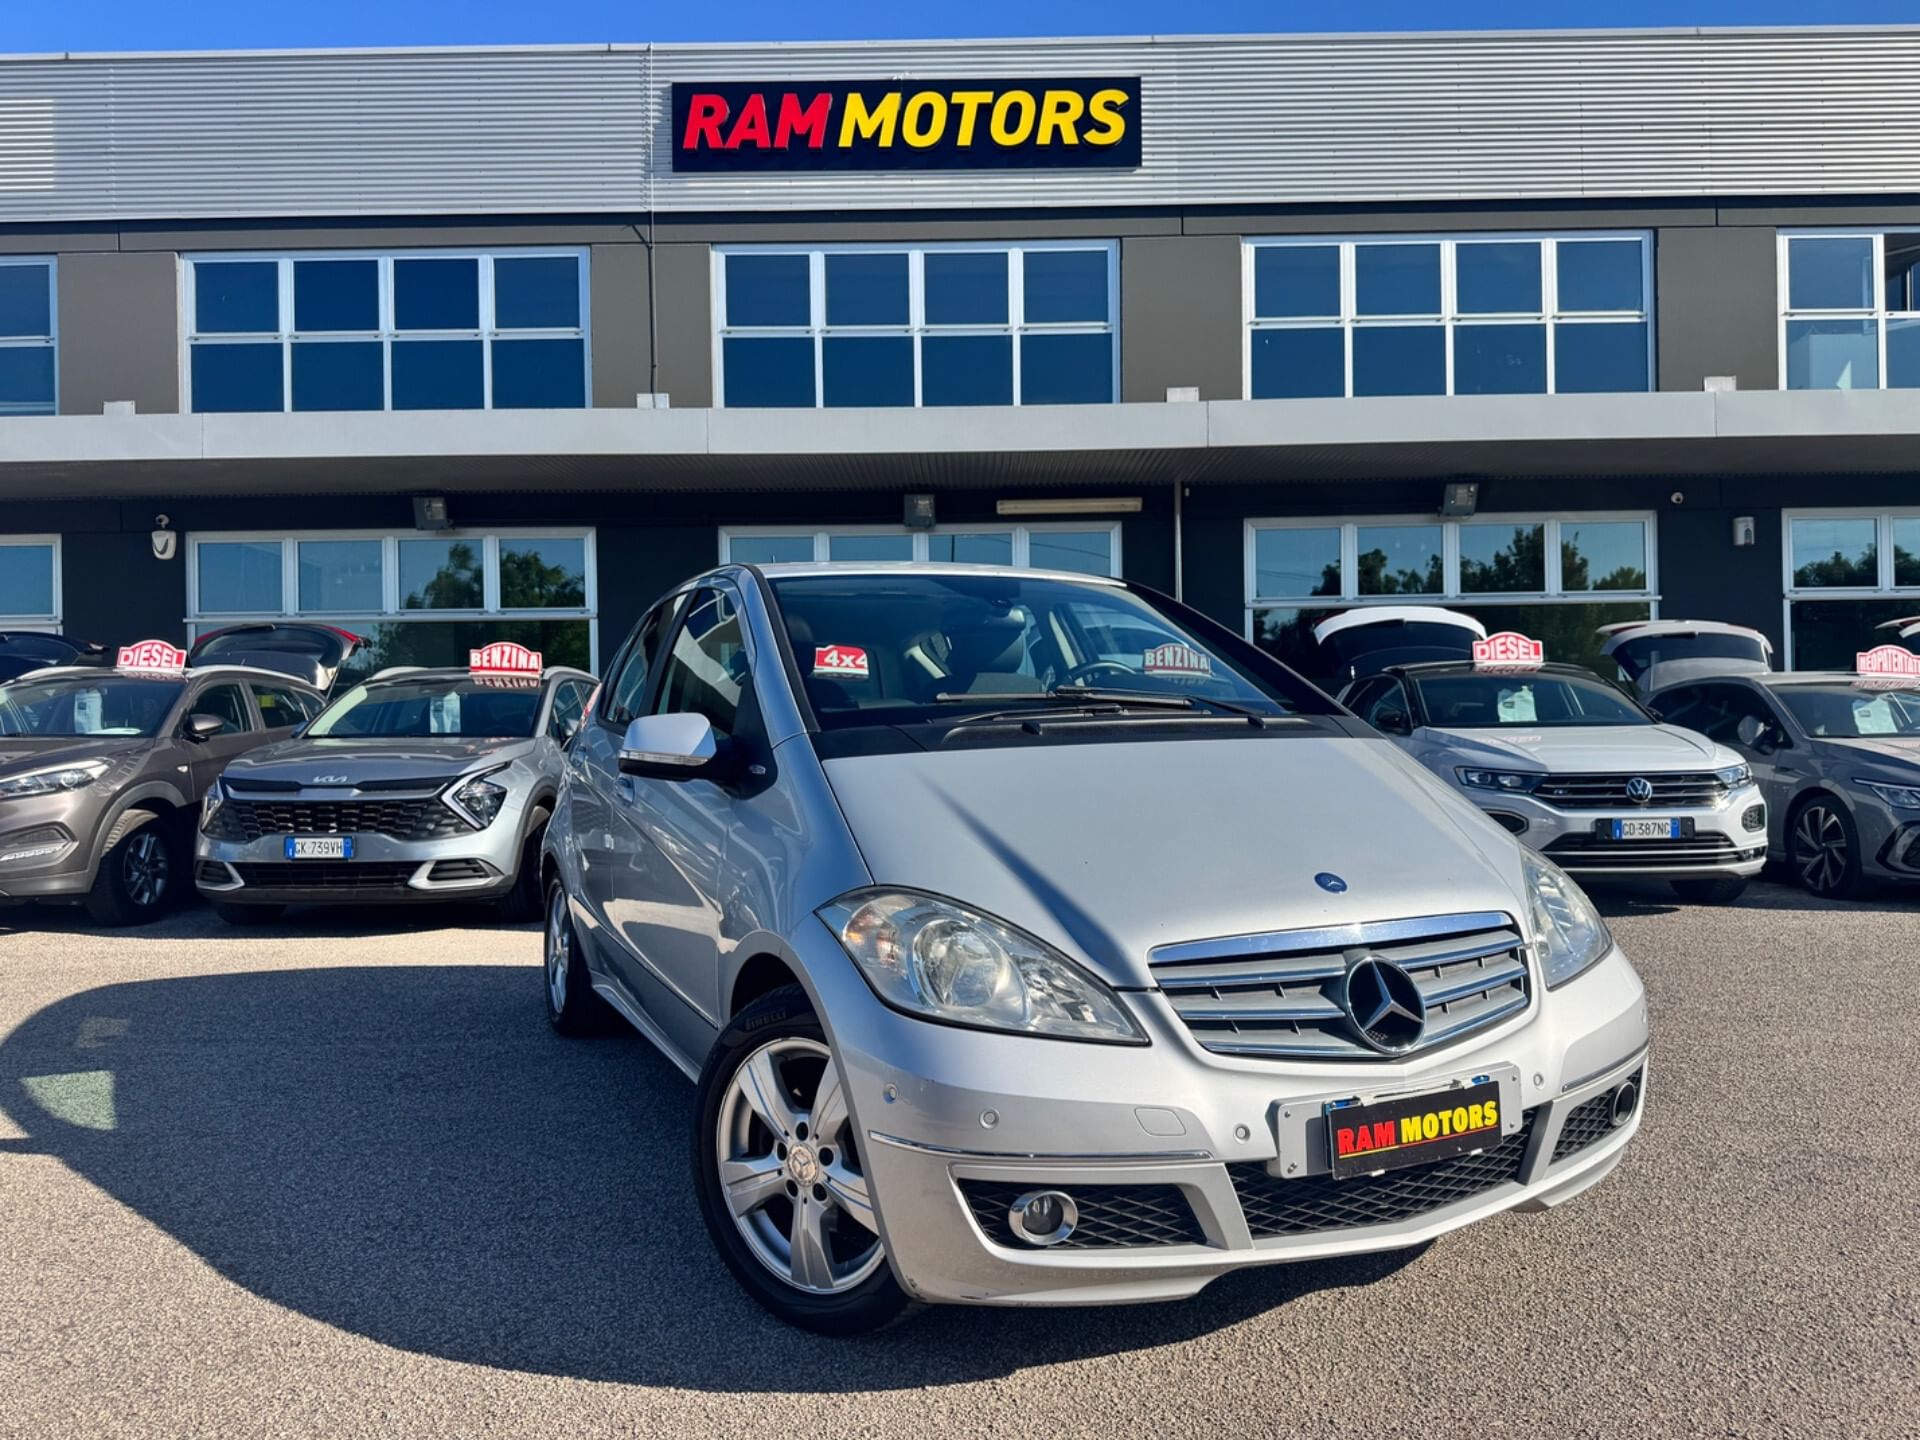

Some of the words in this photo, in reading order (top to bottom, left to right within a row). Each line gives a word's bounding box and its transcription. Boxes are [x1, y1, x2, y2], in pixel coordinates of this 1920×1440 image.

[683, 93, 832, 150] RAM
[838, 89, 1129, 149] MOTORS
[120, 643, 182, 668] DIESEL
[470, 646, 539, 669] BENZINA
[1145, 647, 1208, 669] BENZINA
[1476, 636, 1540, 660] DIESEL
[1337, 1120, 1397, 1154] RAM
[1400, 1101, 1498, 1144] MOTORS
